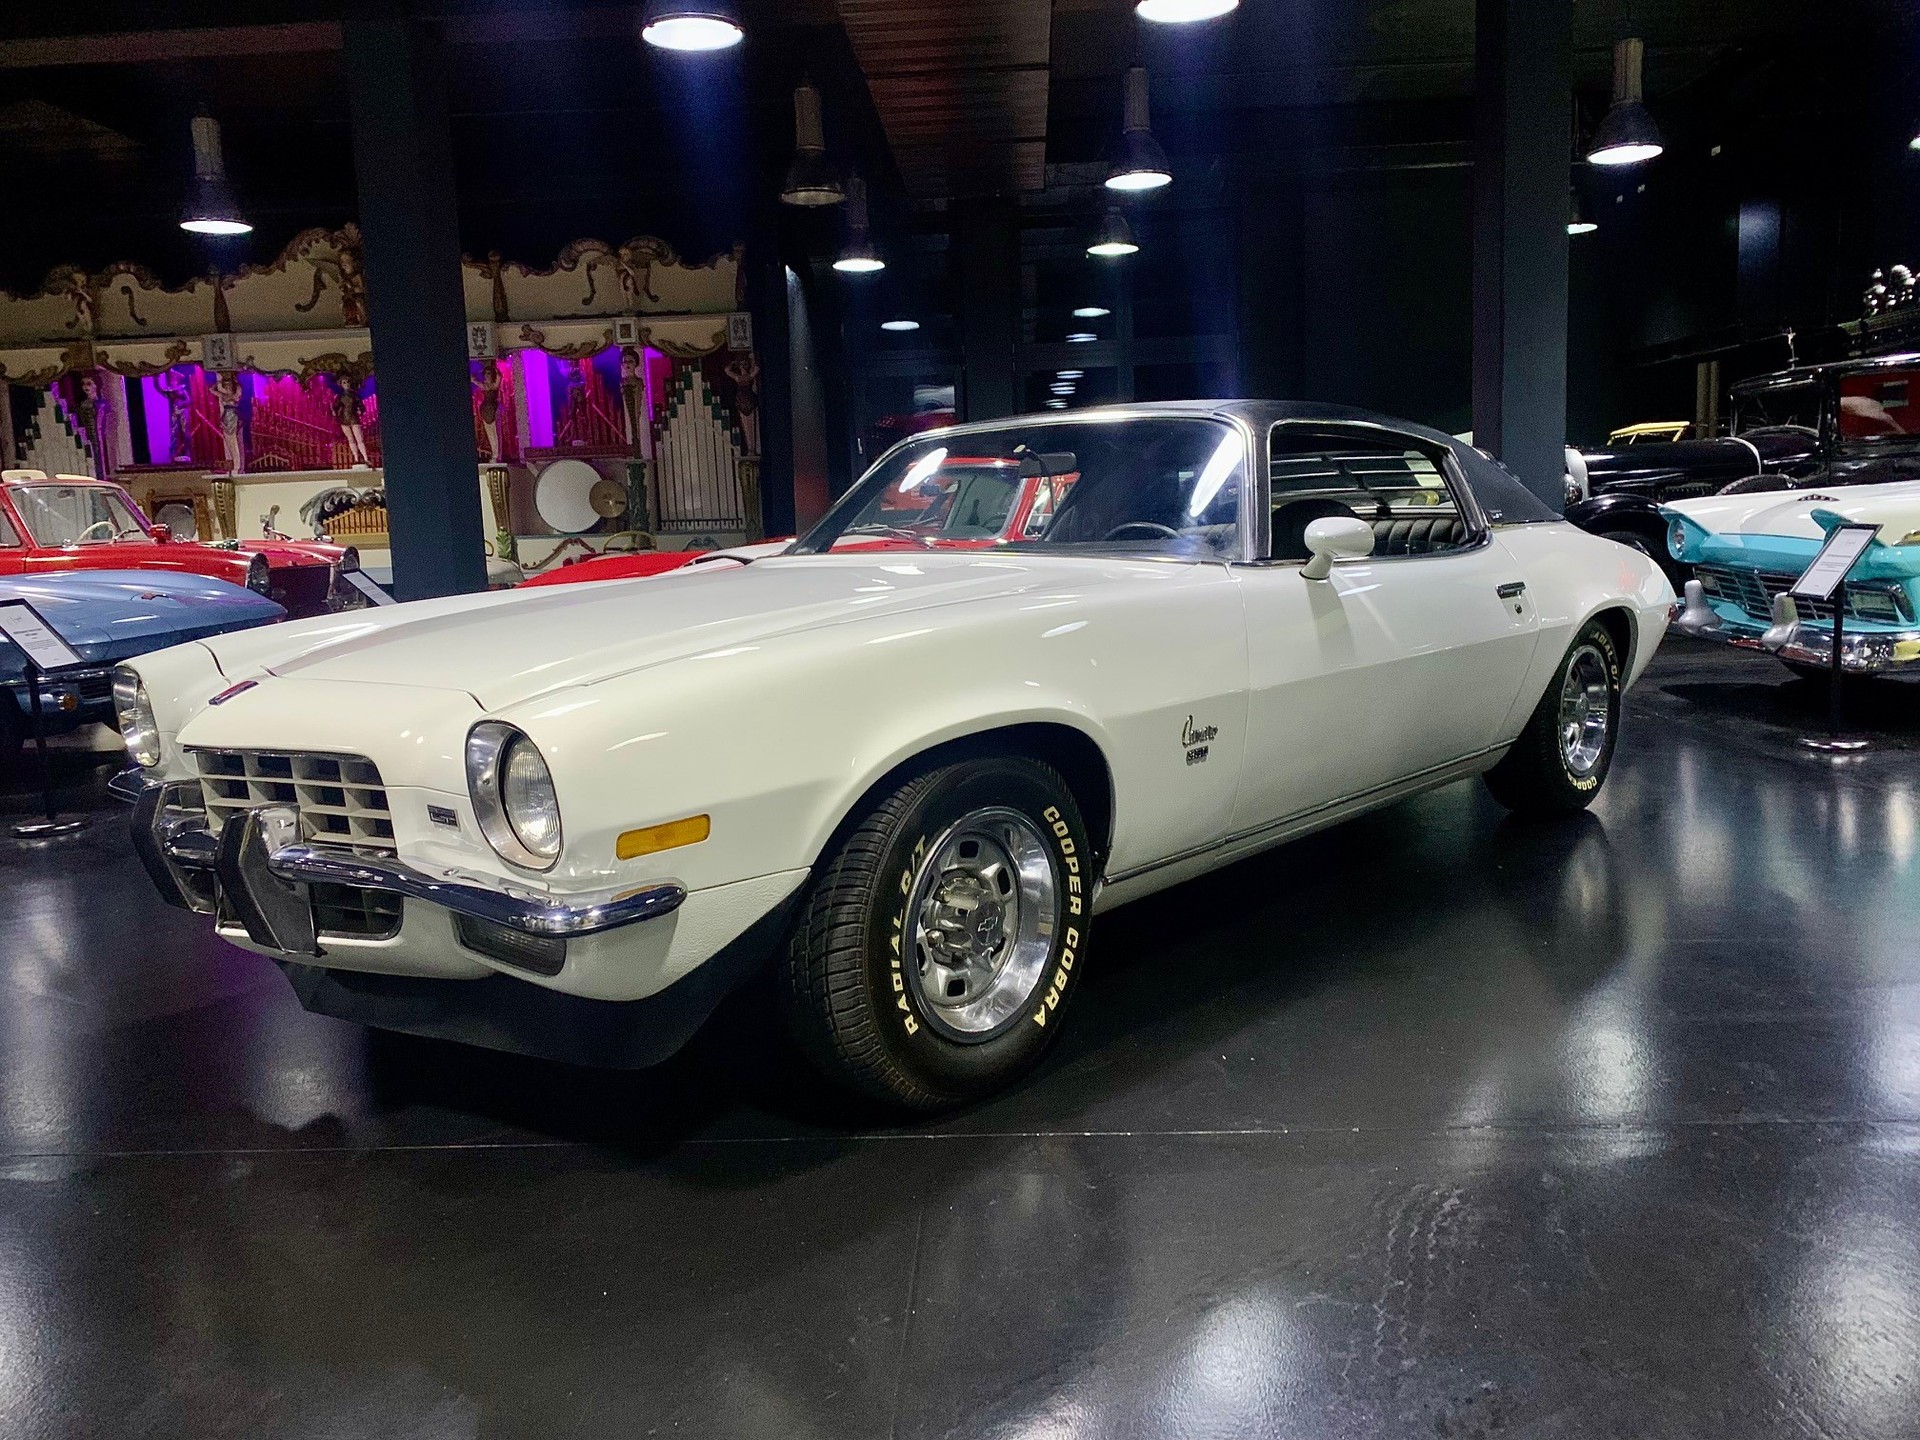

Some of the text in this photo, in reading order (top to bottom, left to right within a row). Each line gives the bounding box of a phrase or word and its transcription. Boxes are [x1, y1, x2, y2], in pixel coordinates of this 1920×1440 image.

[891, 908, 919, 1036] RADIAL
[1032, 805, 1082, 1028] COOPER COBRA
